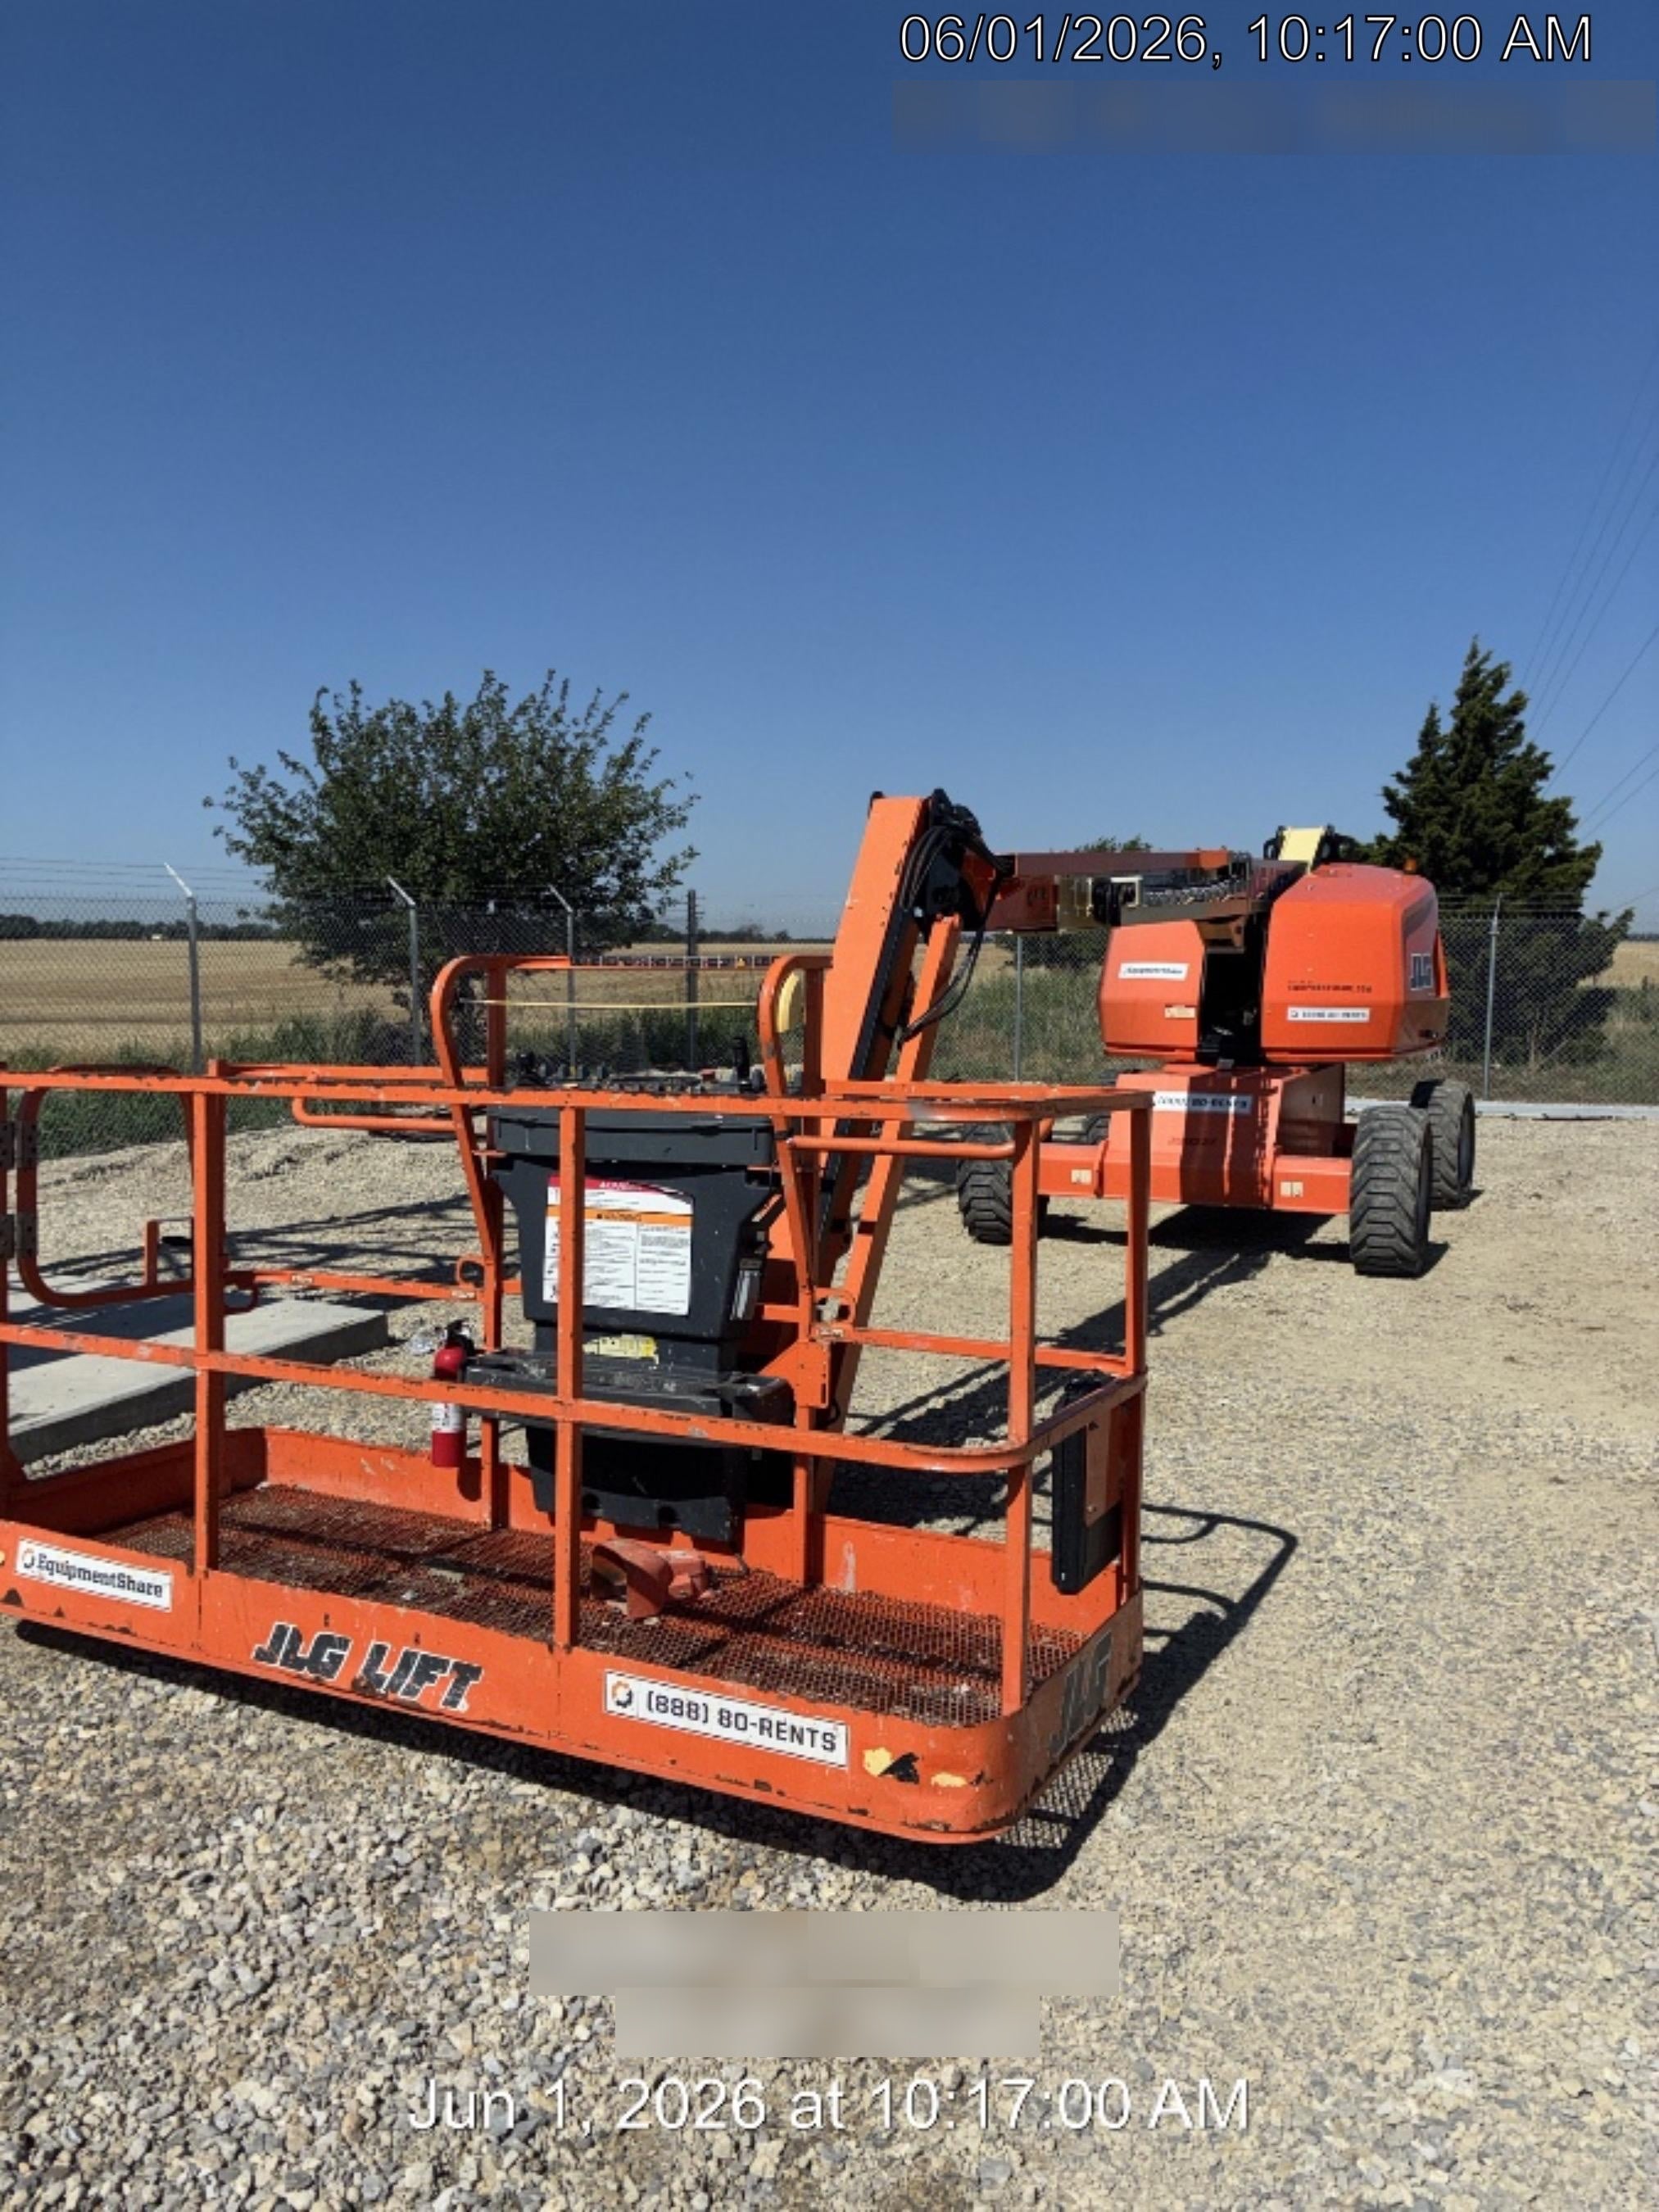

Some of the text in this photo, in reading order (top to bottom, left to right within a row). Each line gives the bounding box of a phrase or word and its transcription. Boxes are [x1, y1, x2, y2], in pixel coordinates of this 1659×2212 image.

[37, 1552, 163, 1598] EquipmentShare
[251, 1621, 485, 1711] JLG LIFT
[646, 1690, 837, 1753] (888) 80-RENTS
